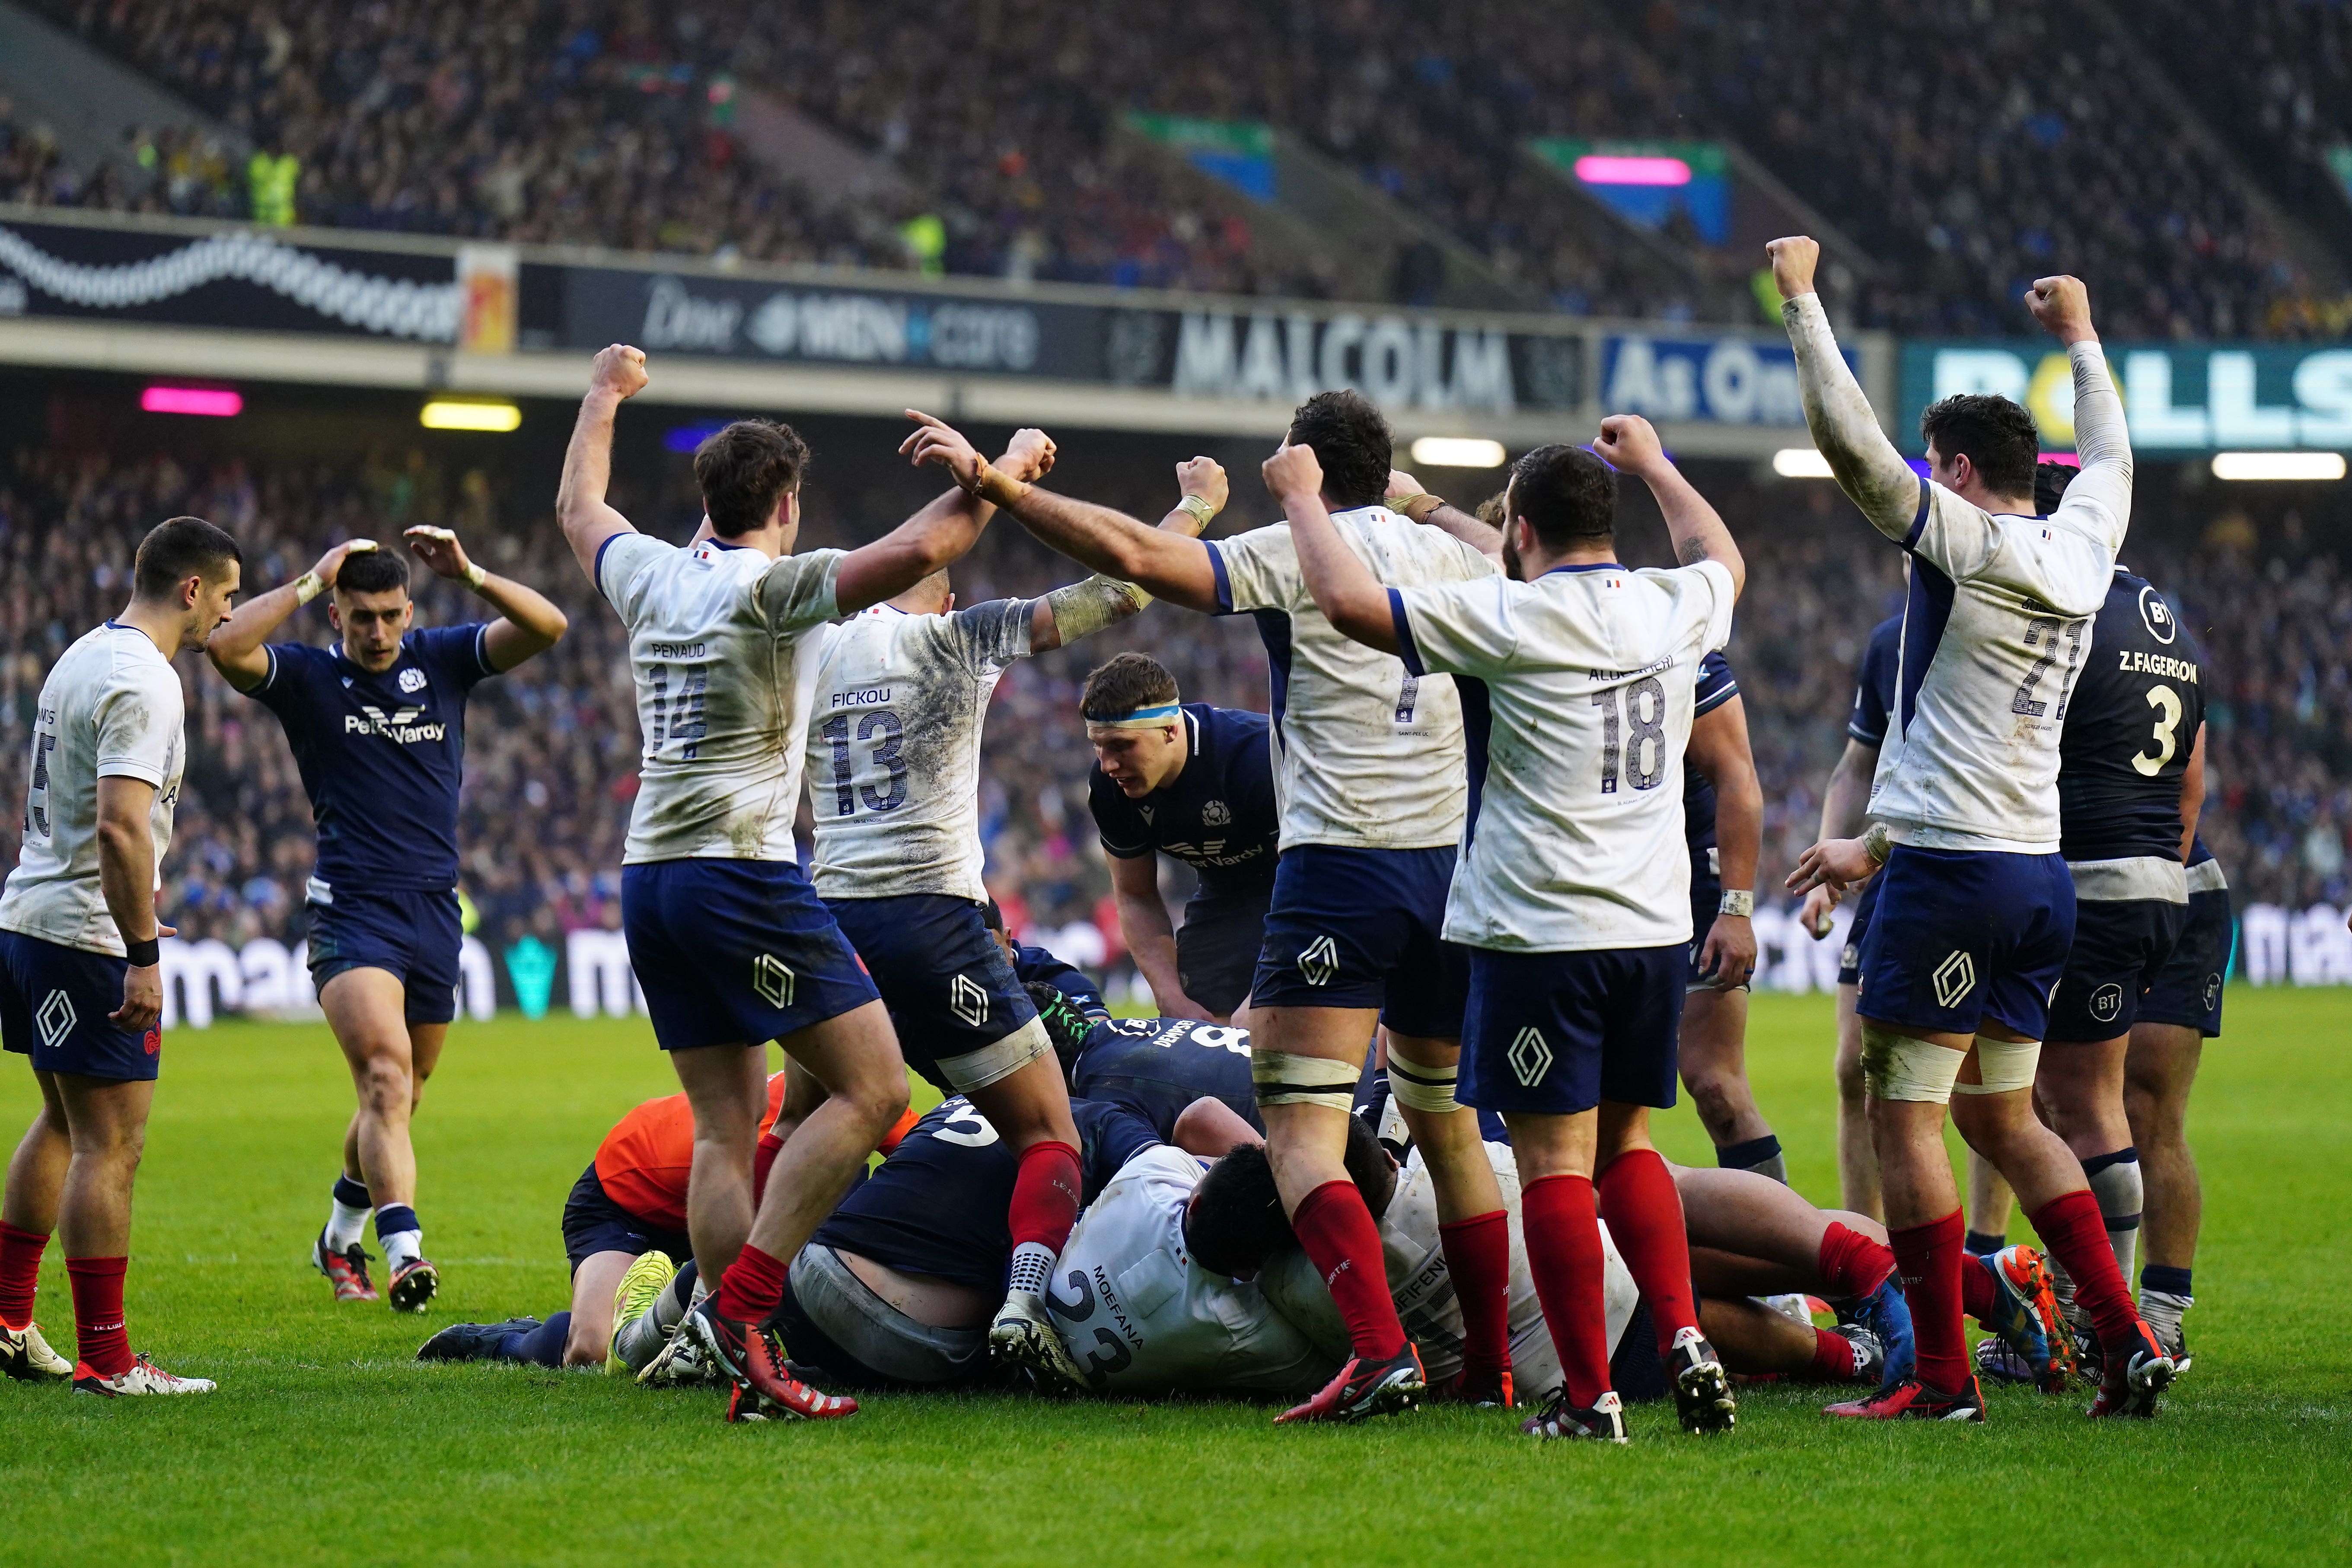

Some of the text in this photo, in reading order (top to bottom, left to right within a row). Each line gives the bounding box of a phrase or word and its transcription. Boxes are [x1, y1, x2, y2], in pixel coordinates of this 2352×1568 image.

[1173, 305, 1517, 416] MALCOLM
[2149, 601, 2171, 625] BT
[651, 643, 705, 658] PENAUD
[2011, 616, 2088, 720] 21
[2119, 650, 2197, 685] Z.FAGERSON
[648, 663, 708, 761] 14
[832, 688, 891, 708] FICKOU
[391, 722, 446, 744] Vardy
[1591, 676, 1665, 794] 18
[2131, 684, 2183, 777] 3
[822, 710, 908, 816] 13
[2098, 994, 2117, 1010] BT
[1152, 1020, 1197, 1048] DEMPSE
[1190, 1025, 1252, 1058] 8
[931, 1105, 1000, 1147] 5
[1045, 1270, 1131, 1383] 23
[1093, 1265, 1144, 1350] MOEFANA
